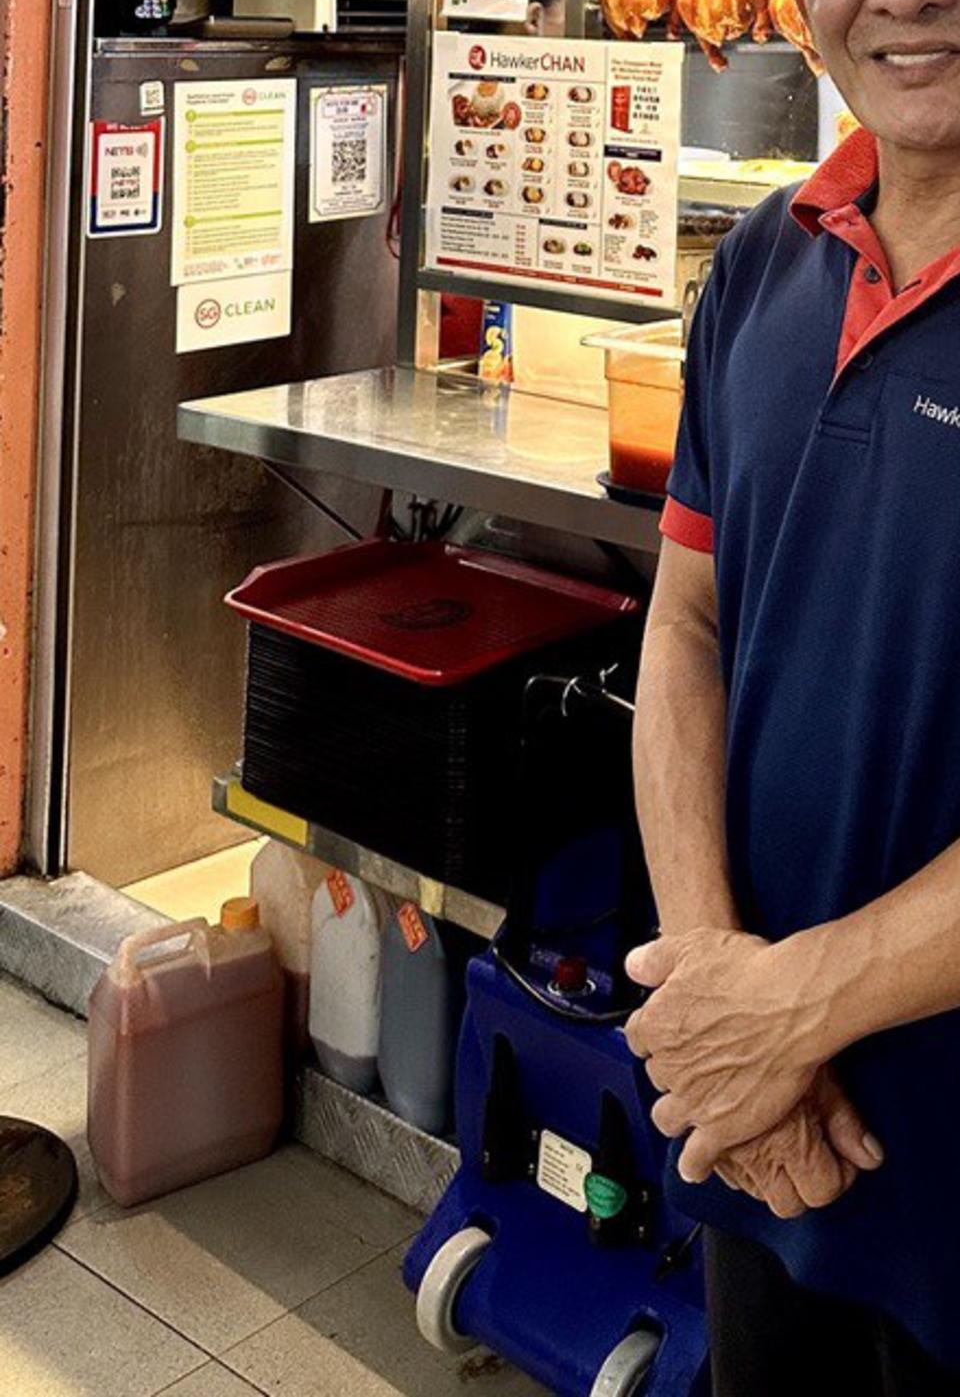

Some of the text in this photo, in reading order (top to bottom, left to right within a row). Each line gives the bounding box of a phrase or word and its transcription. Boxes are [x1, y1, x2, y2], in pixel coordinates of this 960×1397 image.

[490, 52, 585, 73] HawkerCHAN
[200, 297, 276, 322] SG CLEAN
